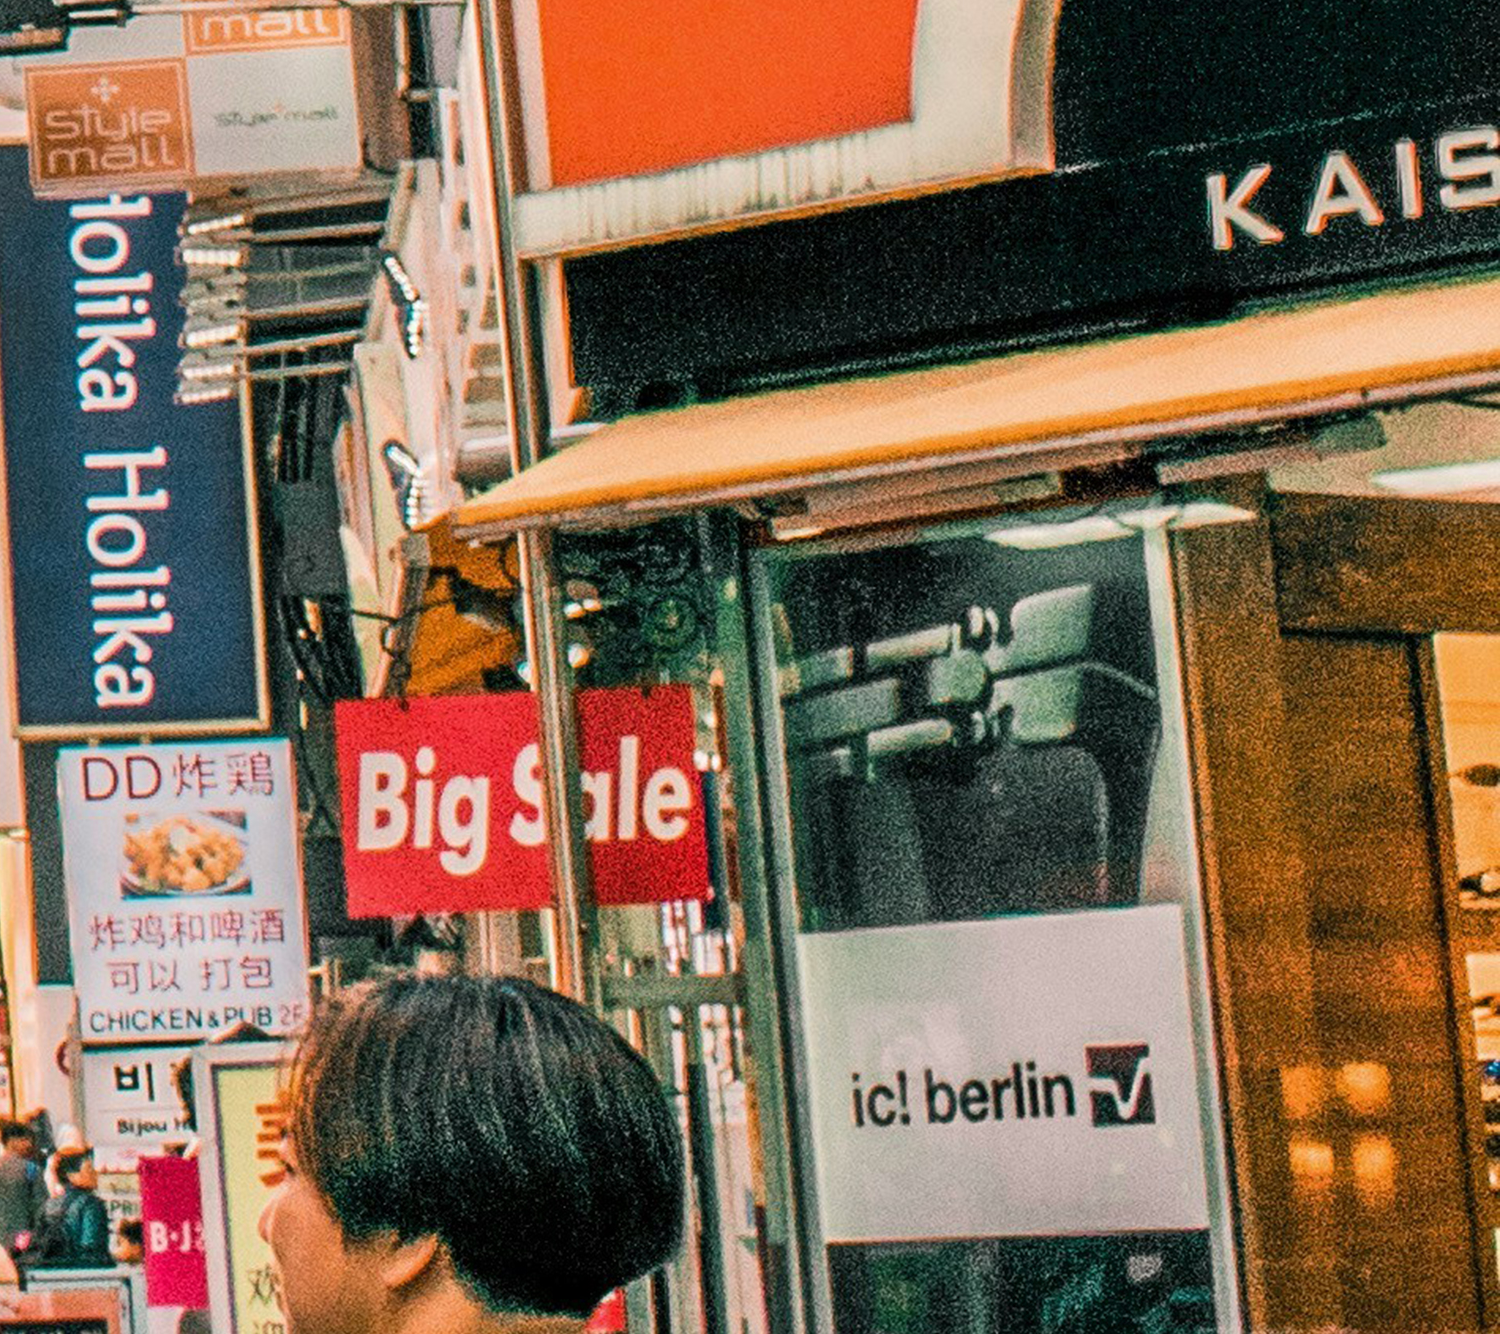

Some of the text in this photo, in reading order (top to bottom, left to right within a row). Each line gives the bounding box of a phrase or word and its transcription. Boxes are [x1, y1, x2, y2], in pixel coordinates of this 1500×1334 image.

[45, 103, 172, 139] style
[48, 134, 178, 175] mall
[81, 446, 174, 711] Holika
[356, 737, 693, 878] Big Sale
[88, 907, 286, 952] 炸鸡和啤酒
[852, 1060, 1077, 1128] ic! berlin
